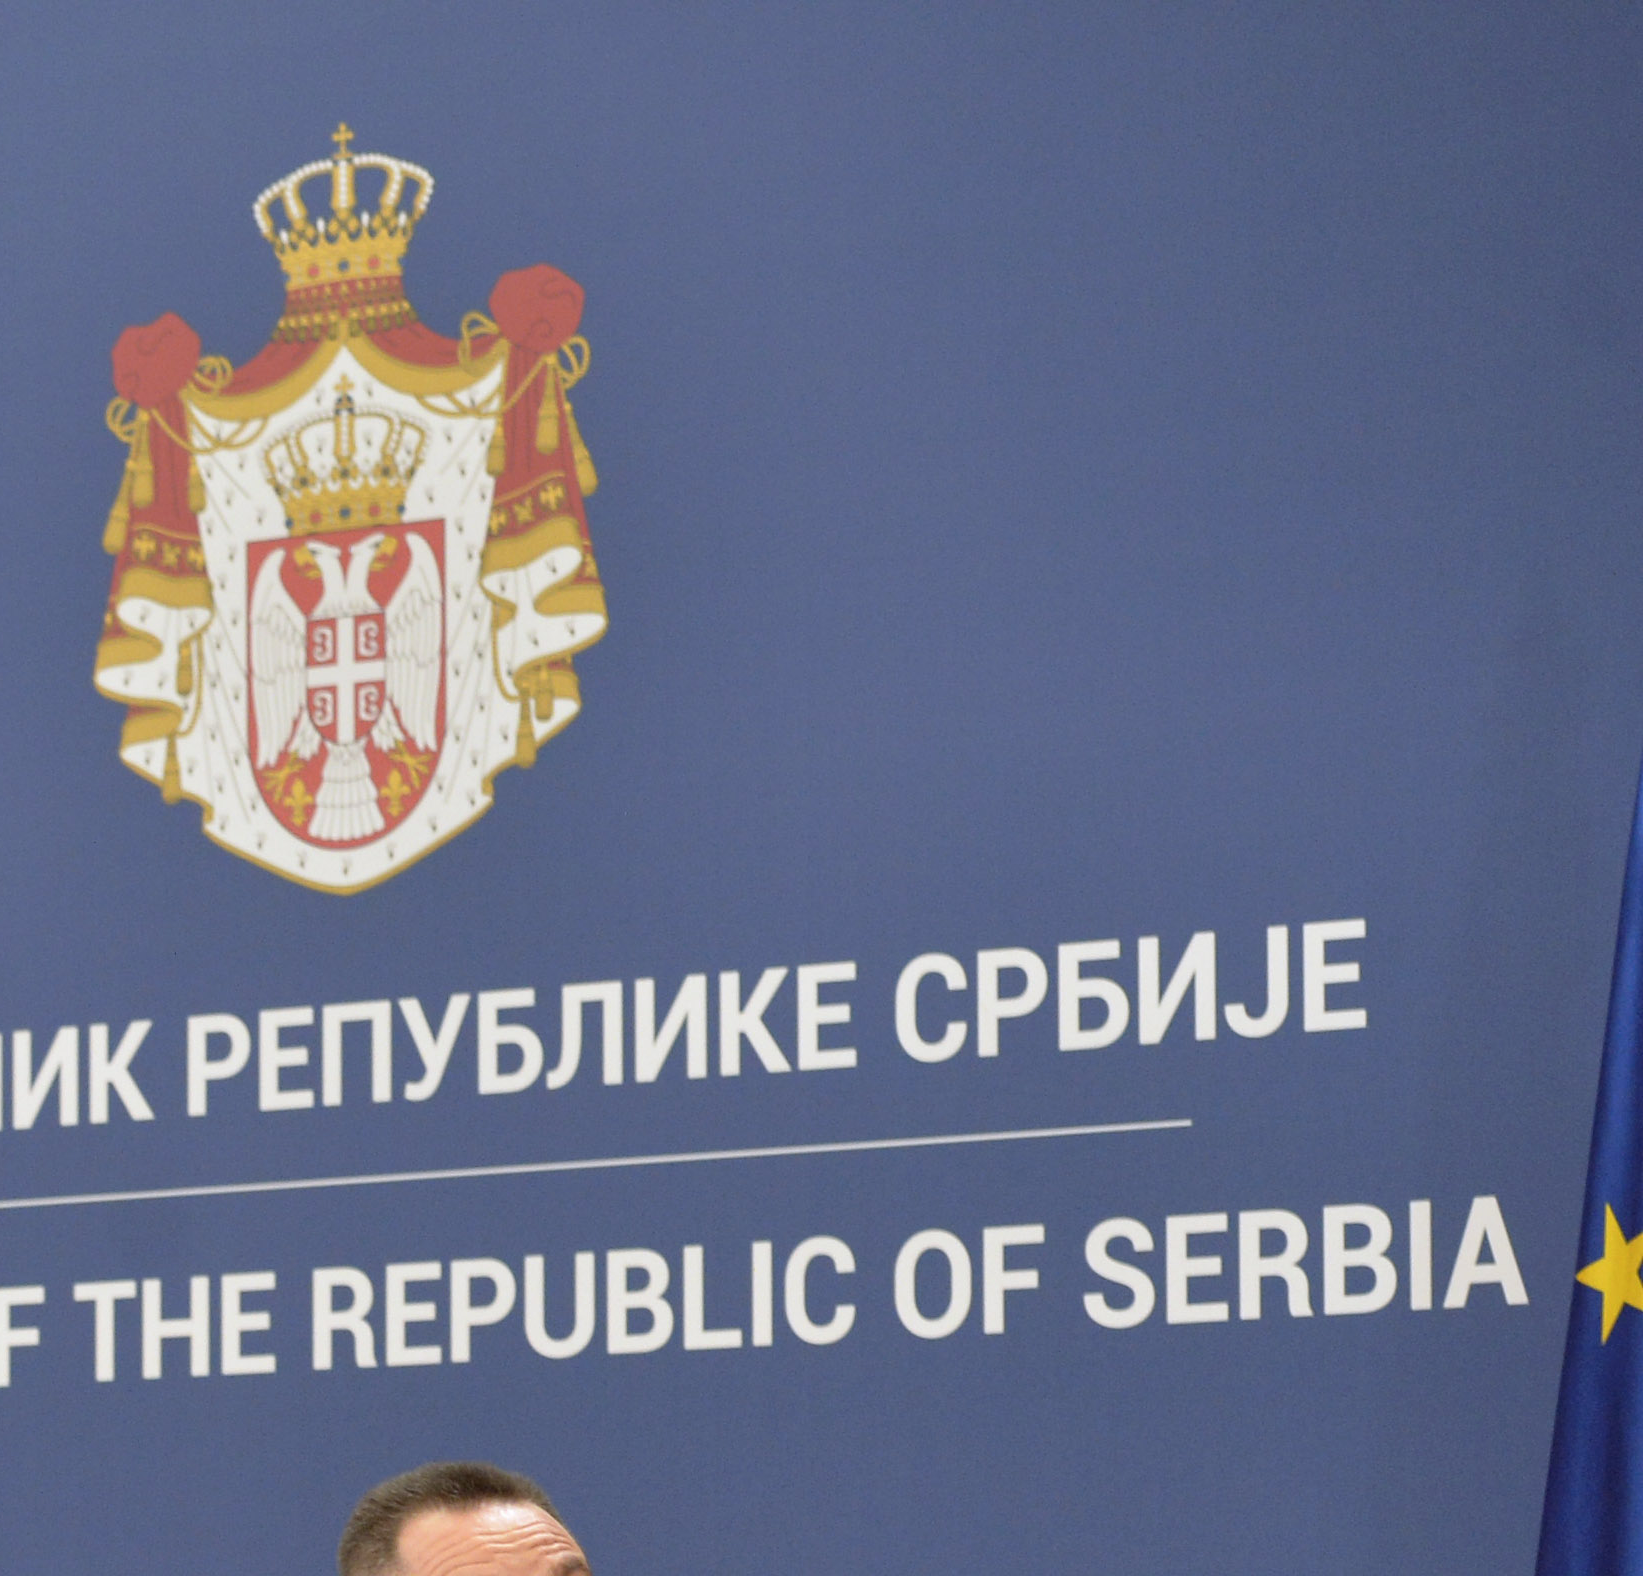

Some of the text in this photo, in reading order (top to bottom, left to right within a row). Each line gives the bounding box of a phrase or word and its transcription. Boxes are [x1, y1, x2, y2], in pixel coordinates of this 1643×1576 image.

[186, 961, 858, 1117] РЕПУБЛИКЕ
[894, 918, 1367, 1063] СРБИЈЕ
[73, 1271, 277, 1382] THE
[312, 1235, 856, 1371] REPUBLIC
[894, 1224, 1045, 1339] OF
[1083, 1195, 1529, 1329] SERBIA
